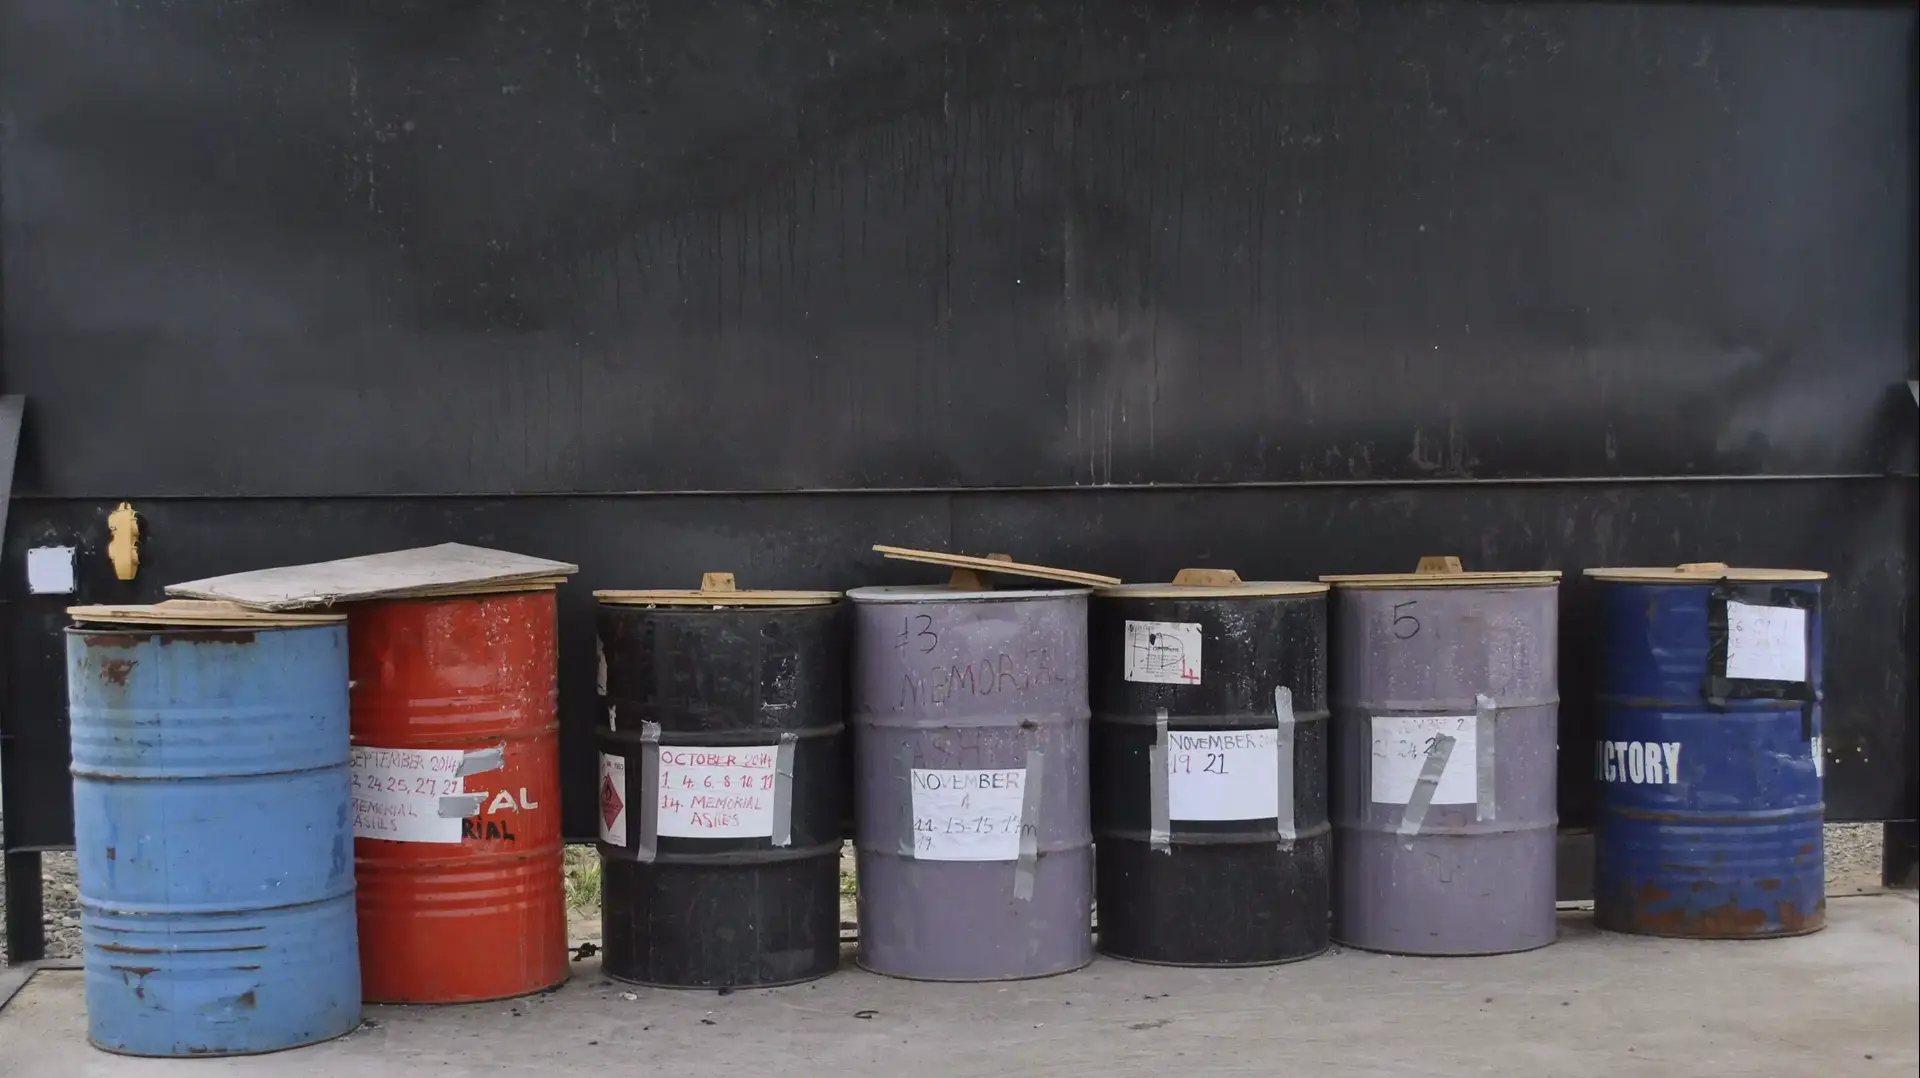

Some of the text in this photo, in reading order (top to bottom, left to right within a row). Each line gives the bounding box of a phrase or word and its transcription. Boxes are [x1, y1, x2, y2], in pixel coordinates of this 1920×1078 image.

[1393, 600, 1420, 639] 5
[1169, 734, 1256, 751] NOVEMBER
[661, 751, 736, 766] OCTOBER
[1169, 753, 1229, 774] 19 21
[913, 770, 1020, 790] NOVEMBER
[690, 795, 762, 811] MEMORIAL
